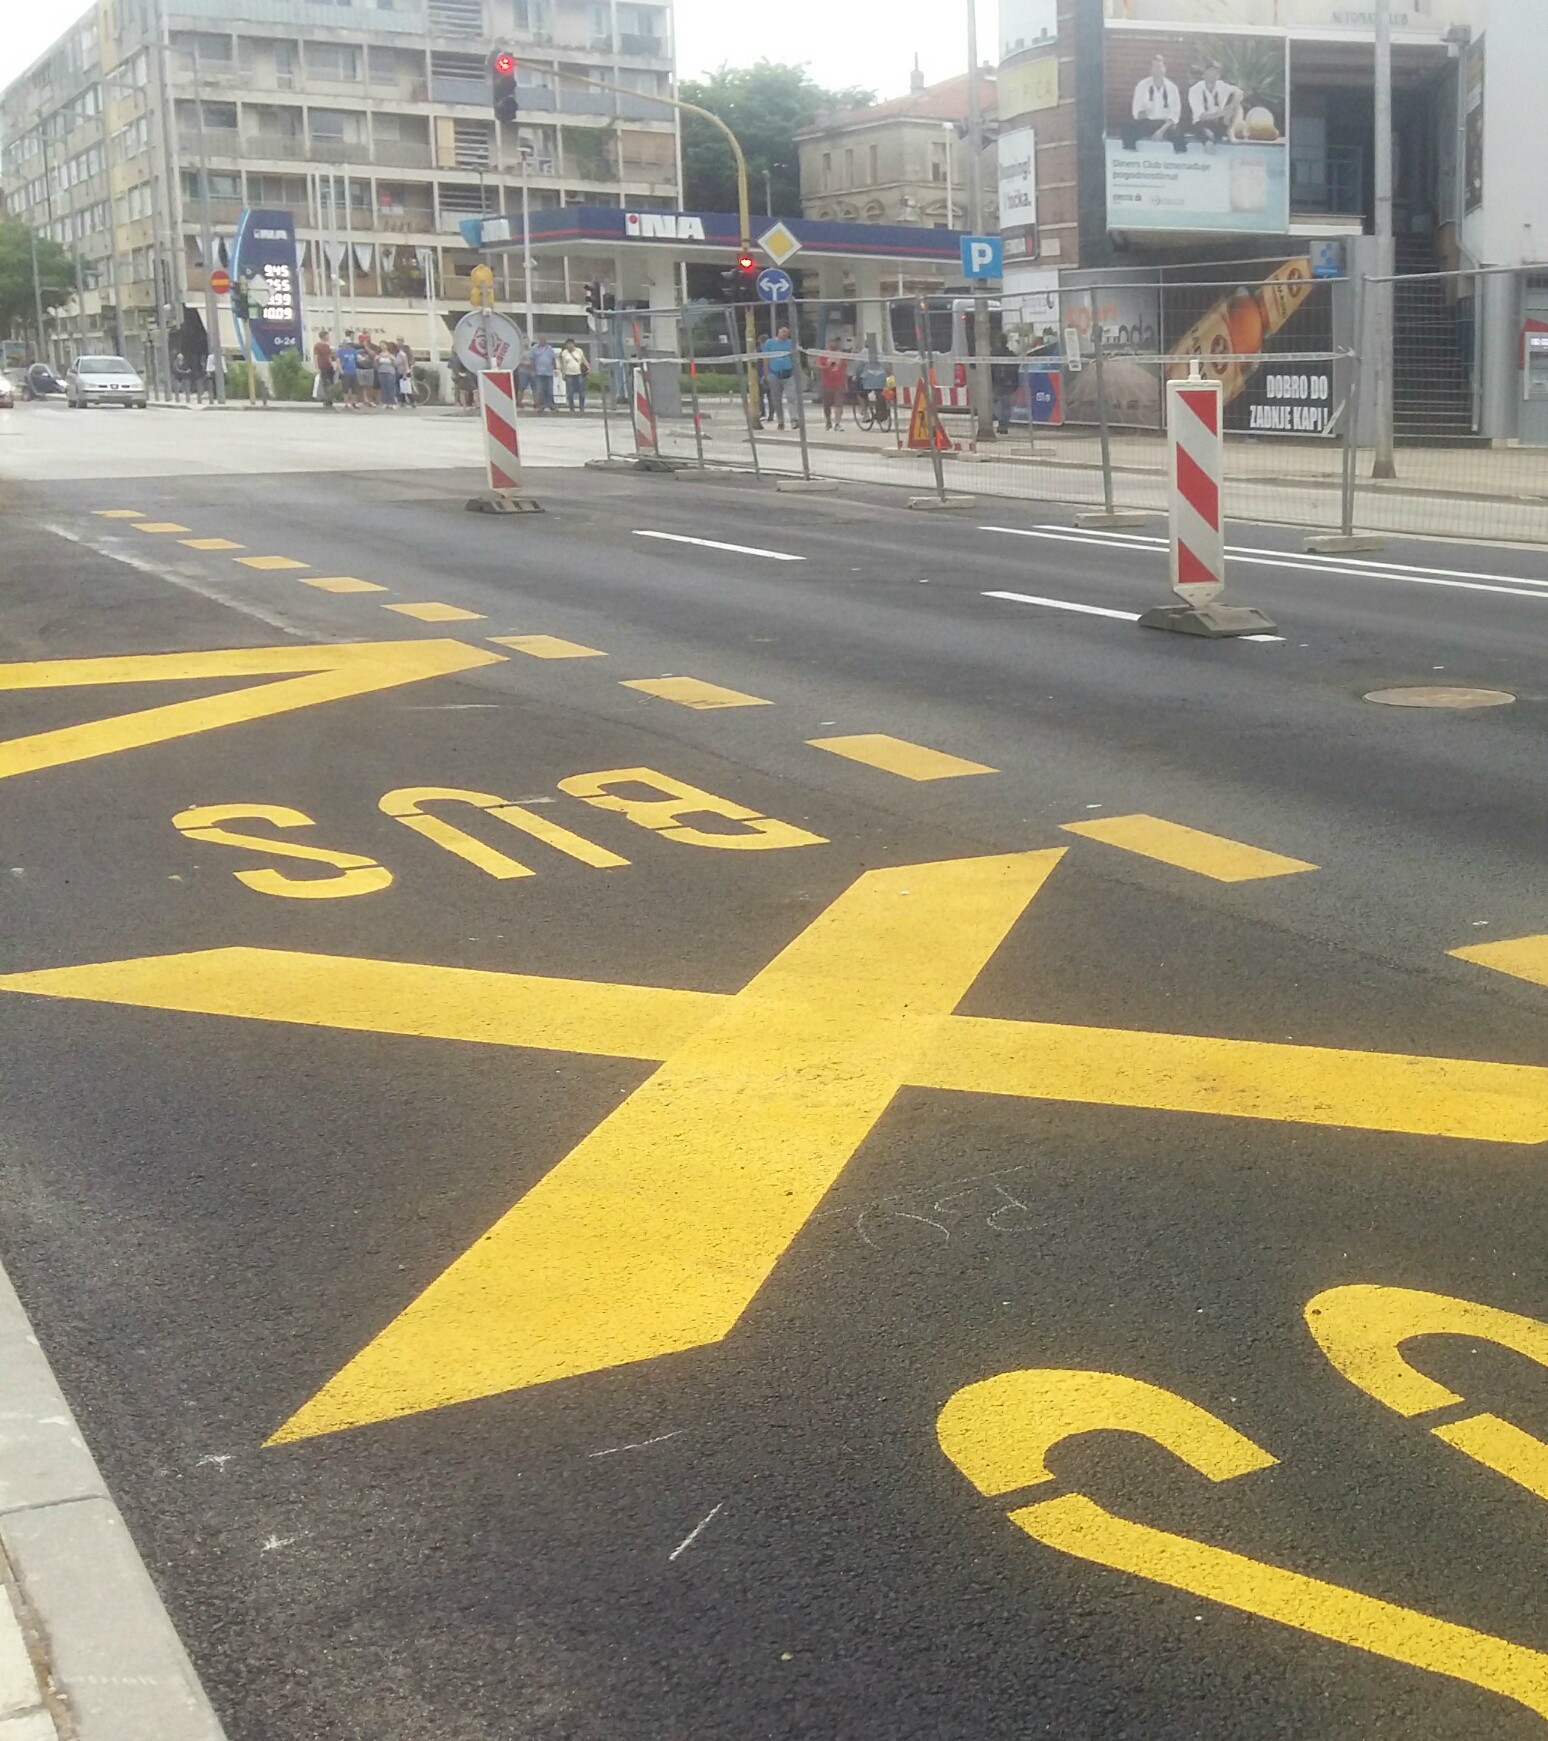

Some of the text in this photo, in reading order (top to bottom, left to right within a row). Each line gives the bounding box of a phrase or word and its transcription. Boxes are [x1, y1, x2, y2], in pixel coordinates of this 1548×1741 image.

[970, 241, 994, 273] P
[273, 336, 296, 346] 0-24
[1266, 374, 1329, 400] DOBRO DO
[1250, 404, 1292, 430] ZADNJE
[171, 767, 830, 899] BUS
